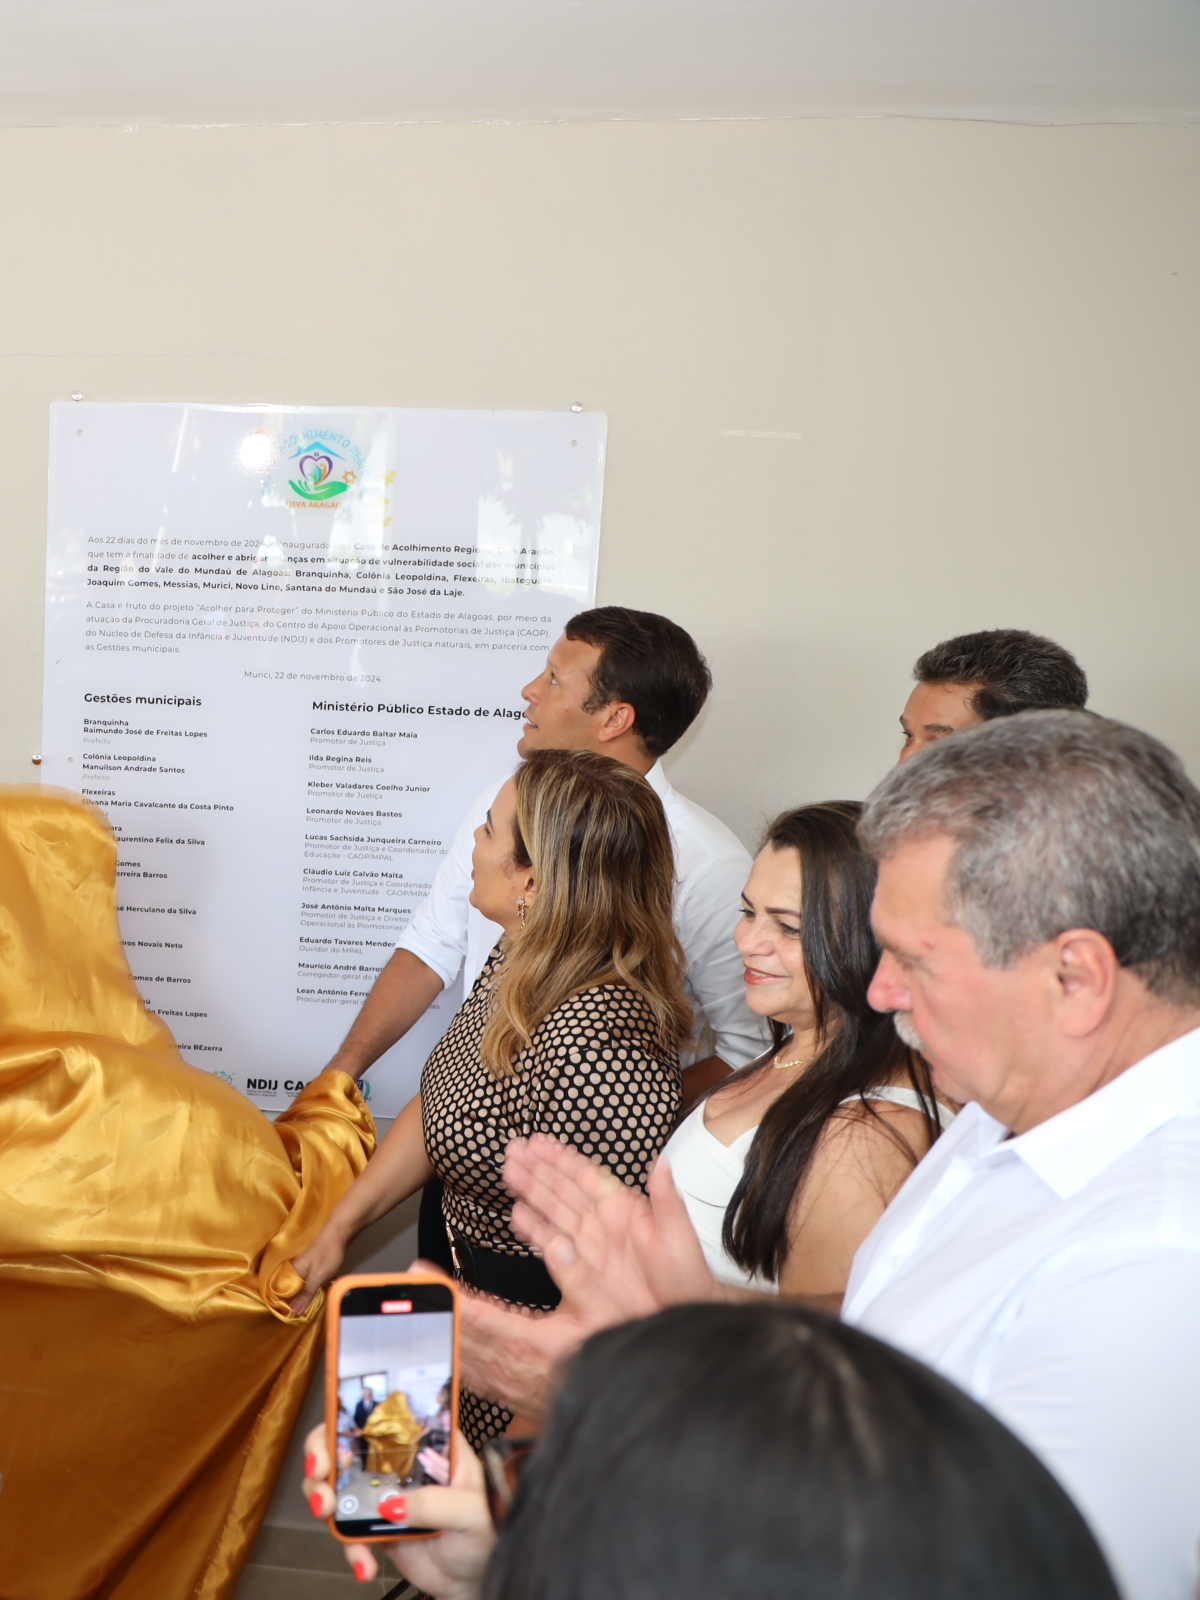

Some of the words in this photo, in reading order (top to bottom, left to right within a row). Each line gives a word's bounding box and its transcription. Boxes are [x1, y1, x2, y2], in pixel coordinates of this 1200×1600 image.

[88, 536, 103, 544] Aos
[118, 536, 135, 545] dias
[185, 538, 228, 547] novembro
[393, 543, 451, 553] Acolhimento
[88, 551, 104, 559] que
[192, 552, 225, 561] acolher
[383, 557, 454, 567] vulnerabilidade
[103, 564, 134, 574] Região
[155, 565, 173, 574] Vale
[195, 567, 231, 575] Mundaú
[296, 570, 351, 580] Branquinha,
[396, 573, 448, 583] Leopoldina,
[87, 578, 125, 588] Joaquim
[128, 580, 161, 589] Gomes,
[164, 580, 200, 590] Messias,
[203, 581, 233, 591] Murici,
[236, 583, 258, 591] Novo
[261, 583, 282, 593] Lino,
[286, 584, 322, 592] Santana
[340, 585, 377, 594] Mundaú
[388, 586, 404, 595] São
[406, 587, 427, 595] José
[444, 588, 465, 598] Laje.
[95, 601, 115, 609] Casa
[125, 601, 147, 610] fruto
[164, 603, 194, 613] projeto
[235, 607, 254, 615] para
[316, 607, 358, 617] Ministério
[361, 609, 394, 618] Público
[411, 611, 441, 619] Estado
[458, 612, 494, 622] Alagoas,
[498, 615, 512, 623] por
[516, 613, 537, 622] meio
[97, 643, 130, 652] Gestões
[244, 669, 272, 680] Murici,
[300, 672, 344, 681] novembro
[84, 693, 132, 704] Gestões
[136, 694, 201, 708] municipais
[312, 700, 374, 712] Ministério
[377, 703, 424, 714] Público
[428, 705, 470, 716] Estado
[474, 706, 489, 716] de
[84, 718, 128, 727] Branquinha
[84, 726, 123, 734] Raimundo
[185, 730, 207, 739] Lopes
[337, 729, 370, 737] Eduardo
[84, 736, 111, 744] Prefeito
[360, 738, 386, 747] Justiça
[114, 754, 156, 763] Leopoldina
[326, 755, 352, 764] Regina
[83, 763, 121, 771] Manuilson
[124, 764, 157, 772] Andrade
[83, 773, 110, 781] Prefeito
[308, 780, 333, 788] Kleber
[336, 782, 373, 790] Valadares
[82, 788, 115, 796] Flexeiras
[134, 801, 176, 809] Cavalcante
[214, 803, 234, 811] Pinto
[307, 807, 343, 815] Leonardo
[156, 836, 173, 844] Felix
[187, 837, 205, 845] Silva
[305, 833, 327, 841] Lucas
[330, 834, 364, 842] Sachsida
[367, 836, 406, 845] Junqueira
[408, 838, 441, 846] Carneiro
[353, 870, 378, 878] Galvão
[381, 871, 403, 879] Malta
[127, 905, 165, 913] Herculano
[179, 907, 196, 915] Silva
[301, 902, 318, 910] José
[378, 906, 411, 915] Marques
[299, 936, 332, 944] Eduardo
[334, 938, 363, 946] Tavares
[299, 945, 328, 953] Ouvidor
[333, 963, 356, 971] André
[167, 975, 191, 983] Barros
[297, 987, 315, 995] Lean
[158, 1008, 183, 1016] Freitas
[185, 1010, 207, 1019] Lopes
[247, 1078, 278, 1091] NDIJ
